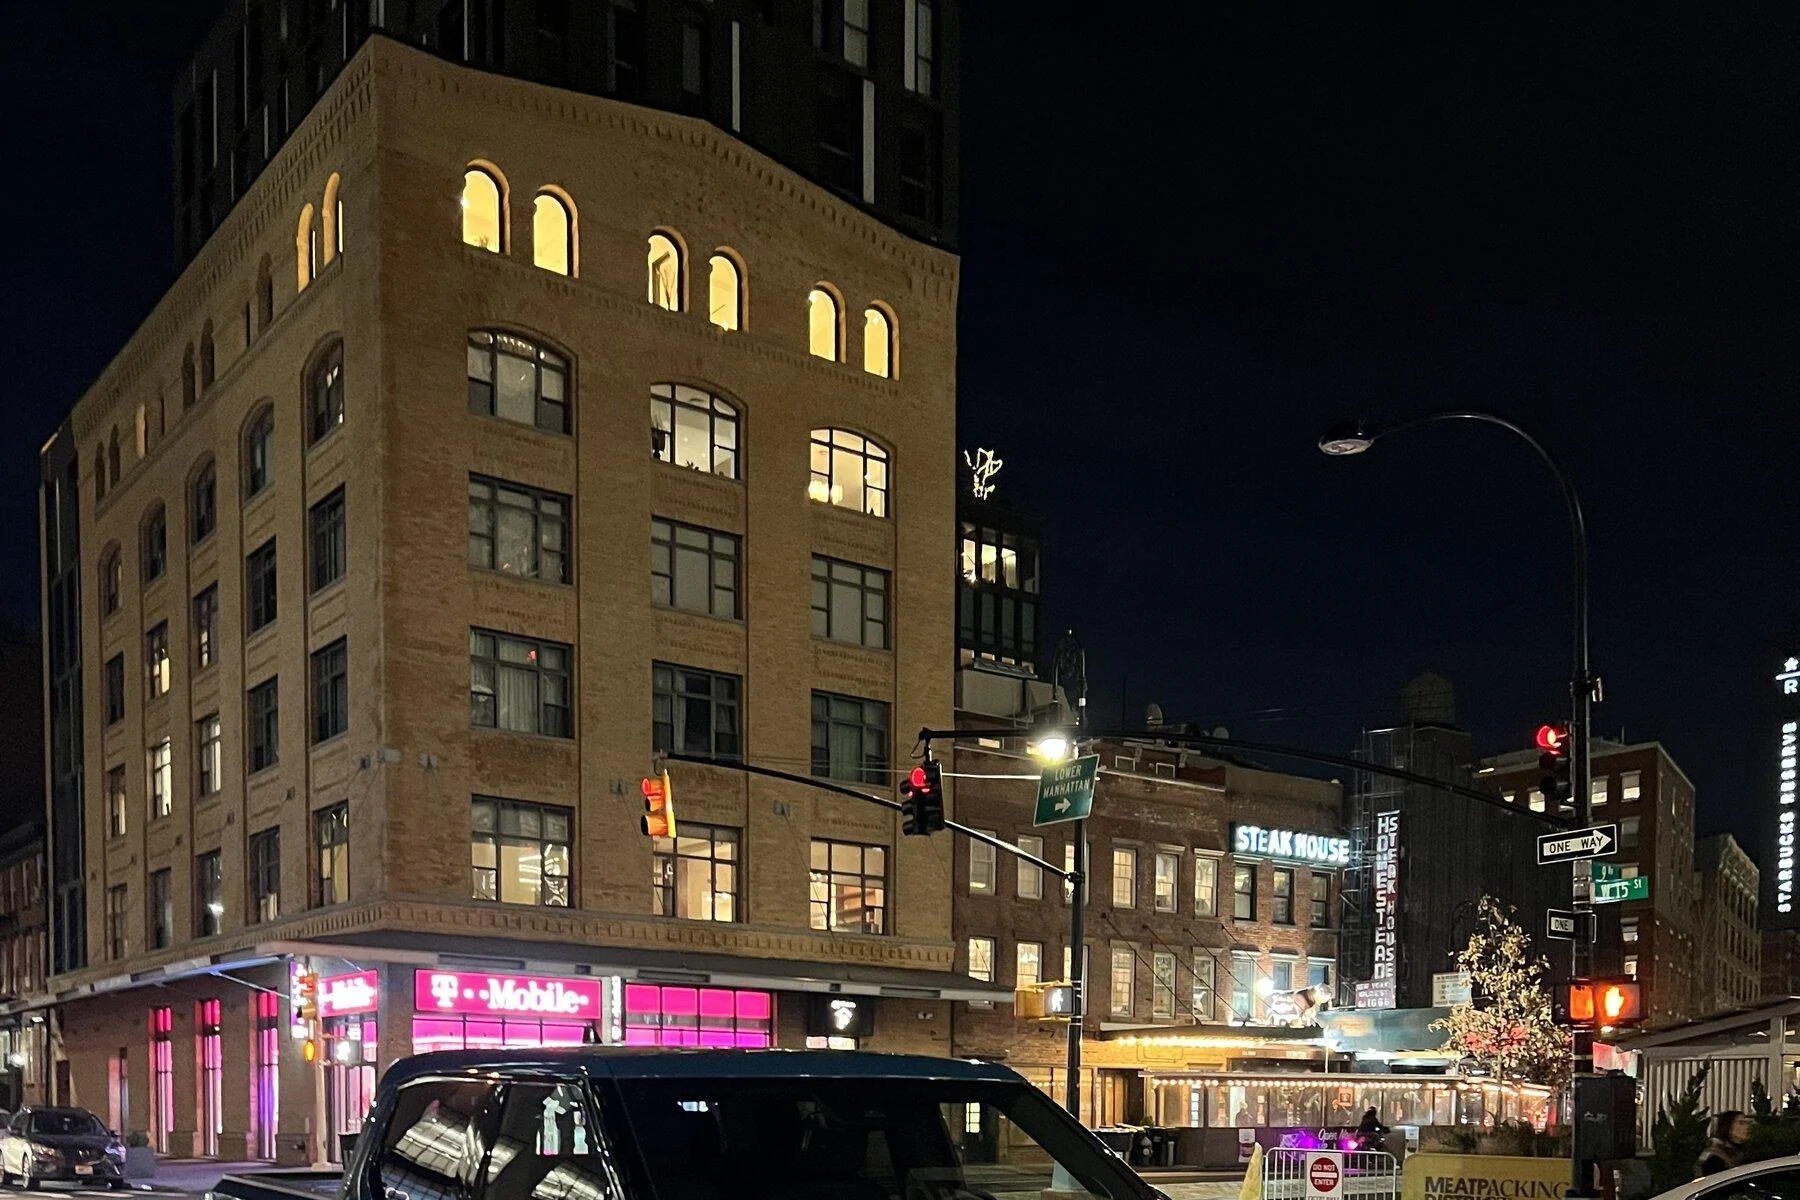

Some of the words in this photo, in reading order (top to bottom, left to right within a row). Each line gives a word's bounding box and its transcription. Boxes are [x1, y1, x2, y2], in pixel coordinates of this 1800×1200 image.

[1055, 765, 1082, 781] LOWER
[1043, 779, 1090, 799] MANHATTAN
[1236, 825, 1293, 857] STEAK
[1295, 833, 1350, 864] HOUSE
[1386, 816, 1398, 894] STEAK
[1549, 841, 1571, 854] ONE
[1581, 836, 1604, 849] WAY
[1777, 811, 1796, 913] STARBUCKS
[1374, 816, 1389, 980] HOMESTEAD
[1601, 884, 1610, 898] W
[1617, 884, 1629, 899] 15
[1554, 919, 1569, 931] ONE
[1385, 900, 1395, 978] HOUSE
[1425, 1176, 1570, 1200] MEATPACKING
